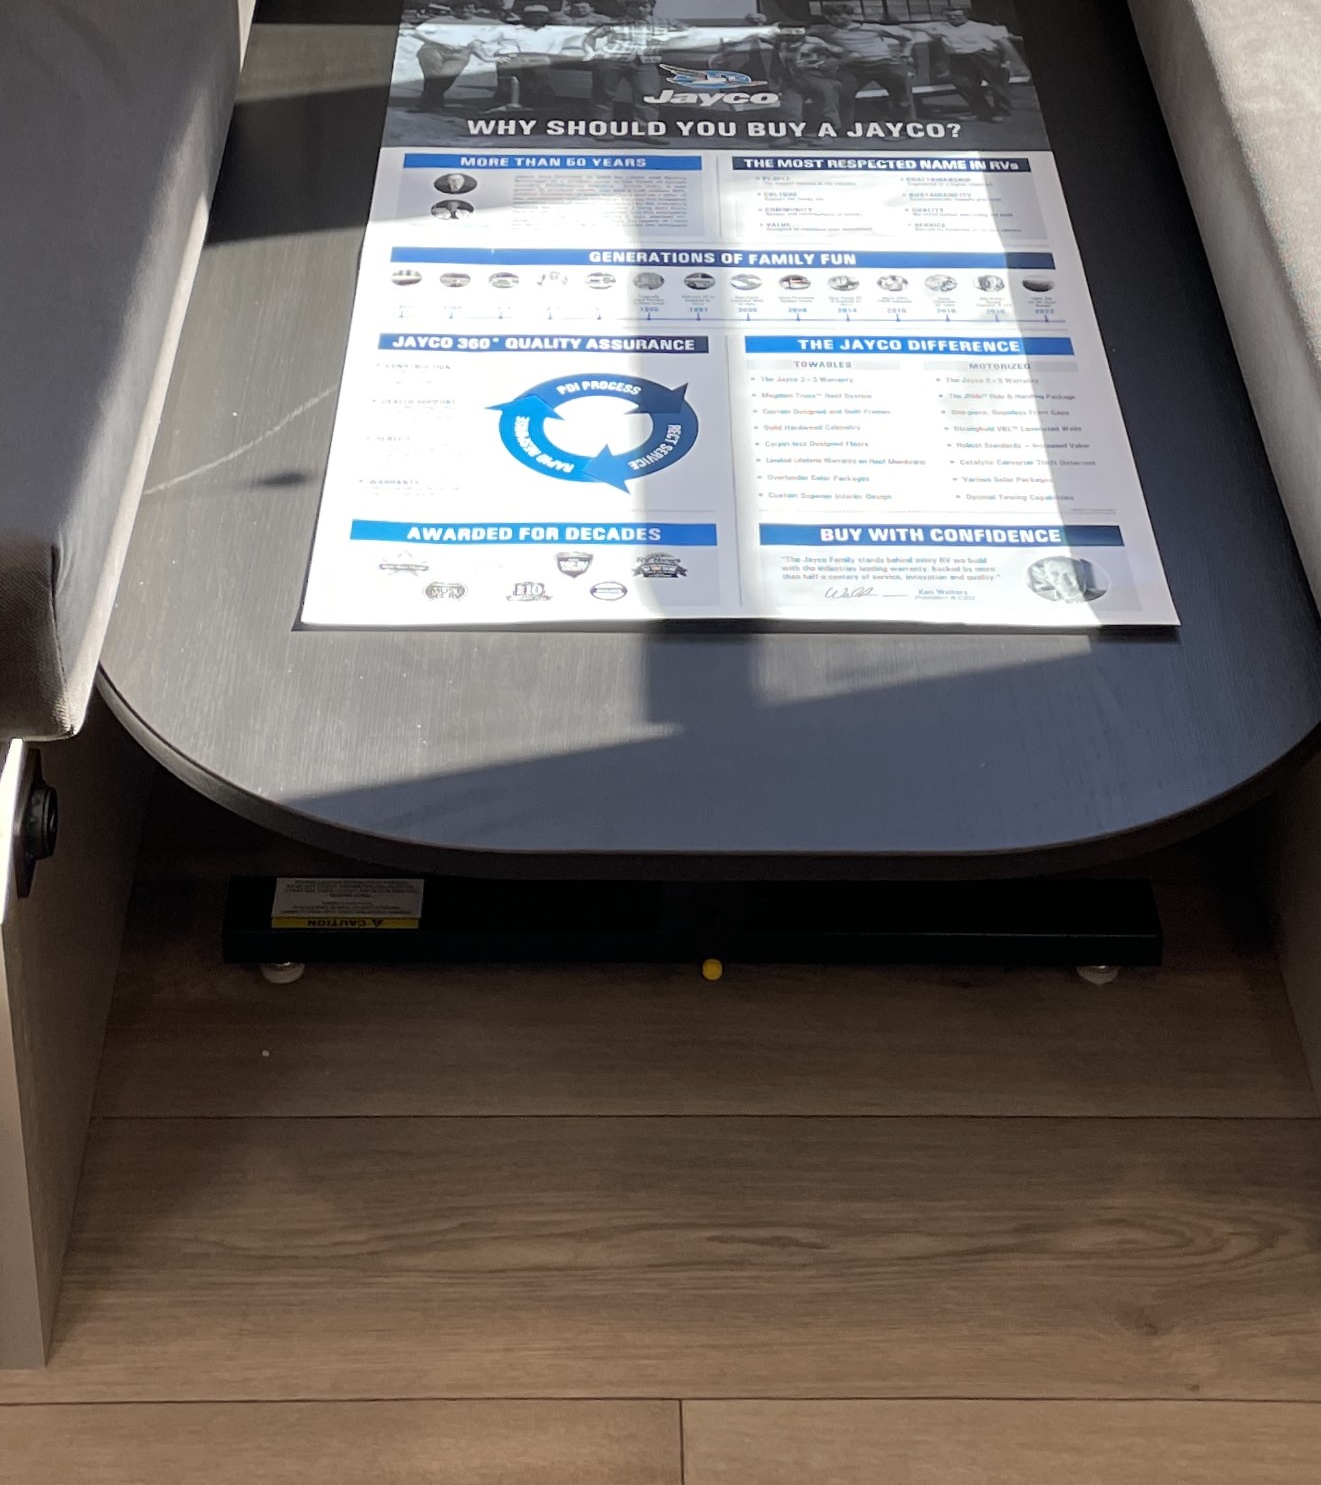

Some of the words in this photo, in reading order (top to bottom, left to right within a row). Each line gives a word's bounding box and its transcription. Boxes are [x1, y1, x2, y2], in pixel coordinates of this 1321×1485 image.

[643, 89, 779, 107] Jayco
[467, 119, 537, 136] WHY
[546, 120, 667, 136] SHOULD
[676, 121, 737, 137] YOU
[747, 121, 807, 137] BUY
[817, 122, 837, 137] A
[846, 122, 961, 138] JAYCO?
[460, 156, 509, 167] MORE
[514, 157, 561, 167] THAN
[591, 157, 647, 168] YEARS
[743, 158, 776, 169] THE
[777, 158, 824, 169] MOST
[828, 159, 917, 170] RESPECTED
[919, 159, 967, 170] NAME
[969, 159, 986, 170] IN
[989, 160, 1019, 171] RVs
[588, 250, 715, 264] GENERATIONS
[721, 252, 743, 265] OF
[748, 252, 814, 265] FAMILY
[819, 253, 857, 265] FUN
[392, 337, 453, 349] JAYCO
[505, 337, 582, 350] QUALITY
[585, 338, 695, 351] ASSURANCE
[797, 339, 833, 351] THE
[839, 339, 902, 351] JAYCO
[907, 339, 1020, 352] DIFFERENCE
[556, 381, 580, 395] PDI
[581, 381, 642, 396] PROCESS
[628, 443, 674, 470] SERVICE
[406, 527, 513, 541] AWARDED
[519, 527, 559, 541] FOR
[565, 527, 661, 541] DECADES
[820, 528, 862, 542] BUY
[867, 528, 924, 542] WITH
[930, 528, 1061, 543] CONFIDENCE
[307, 918, 367, 927] CAUTION
